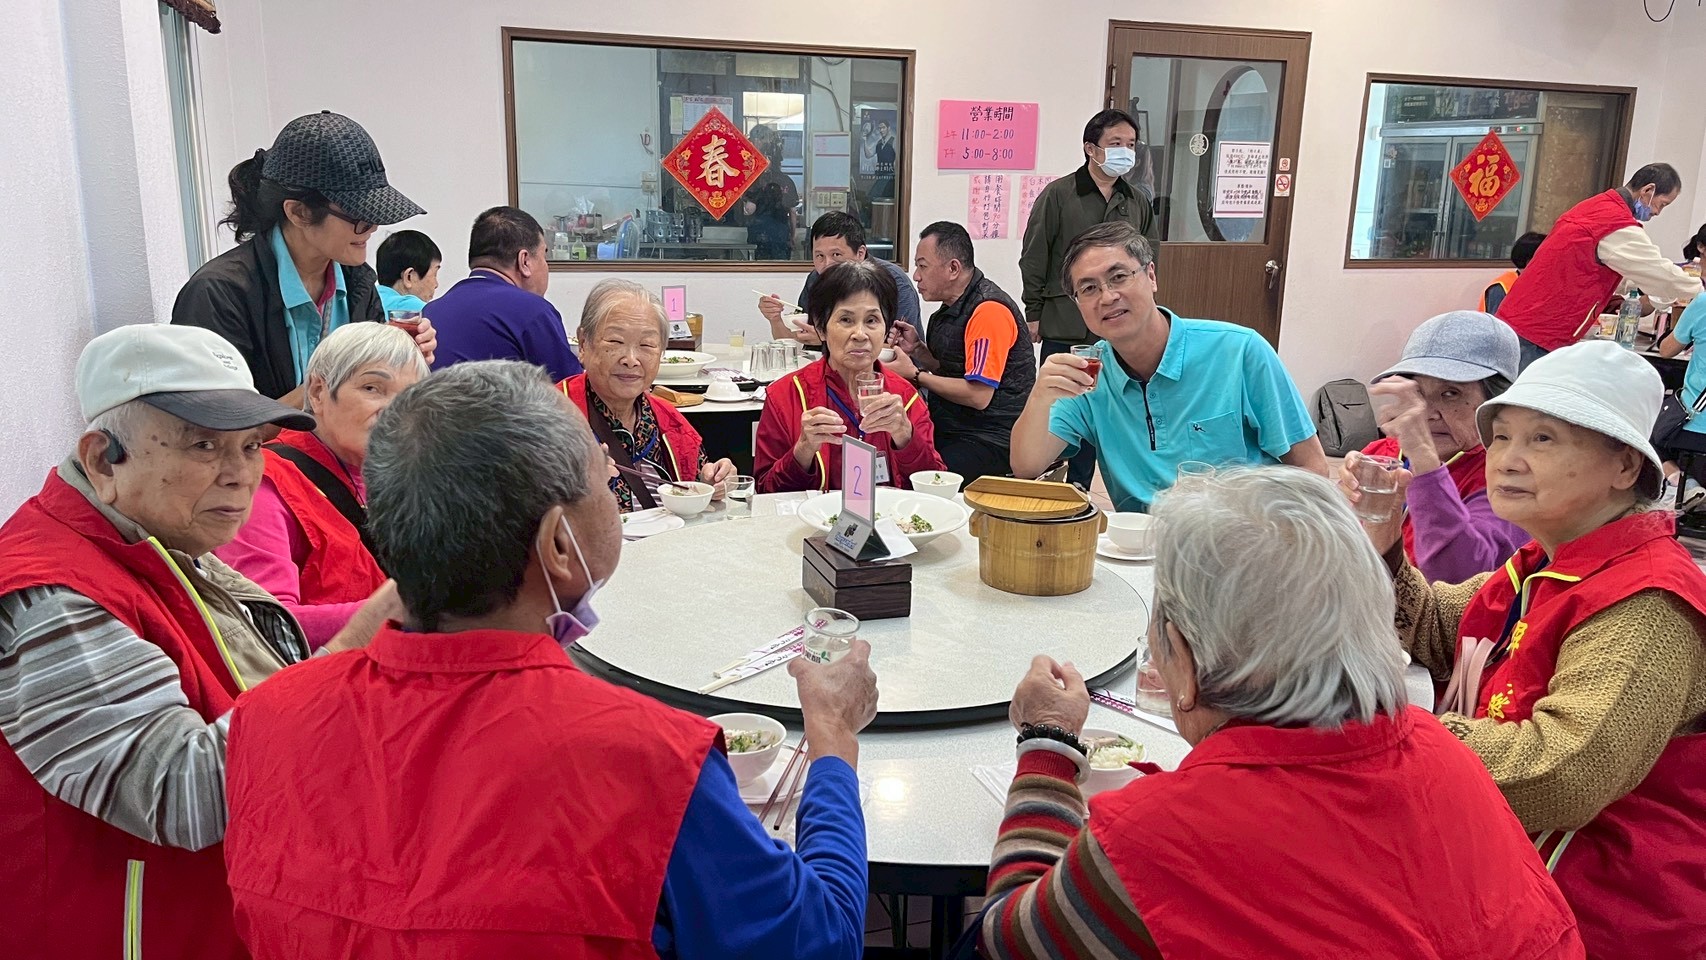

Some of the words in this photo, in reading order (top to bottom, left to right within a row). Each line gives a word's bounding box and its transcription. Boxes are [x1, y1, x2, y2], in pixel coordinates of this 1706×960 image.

[970, 106, 1014, 121] 營業時間
[943, 130, 957, 139] 上午
[961, 128, 1014, 140] 11:00-2:00
[698, 135, 740, 188] 春
[944, 148, 955, 159] 下午
[962, 147, 1014, 161] 5:00-8:00
[1468, 154, 1501, 197] 福
[671, 297, 677, 312] 1
[853, 465, 863, 496] 2
